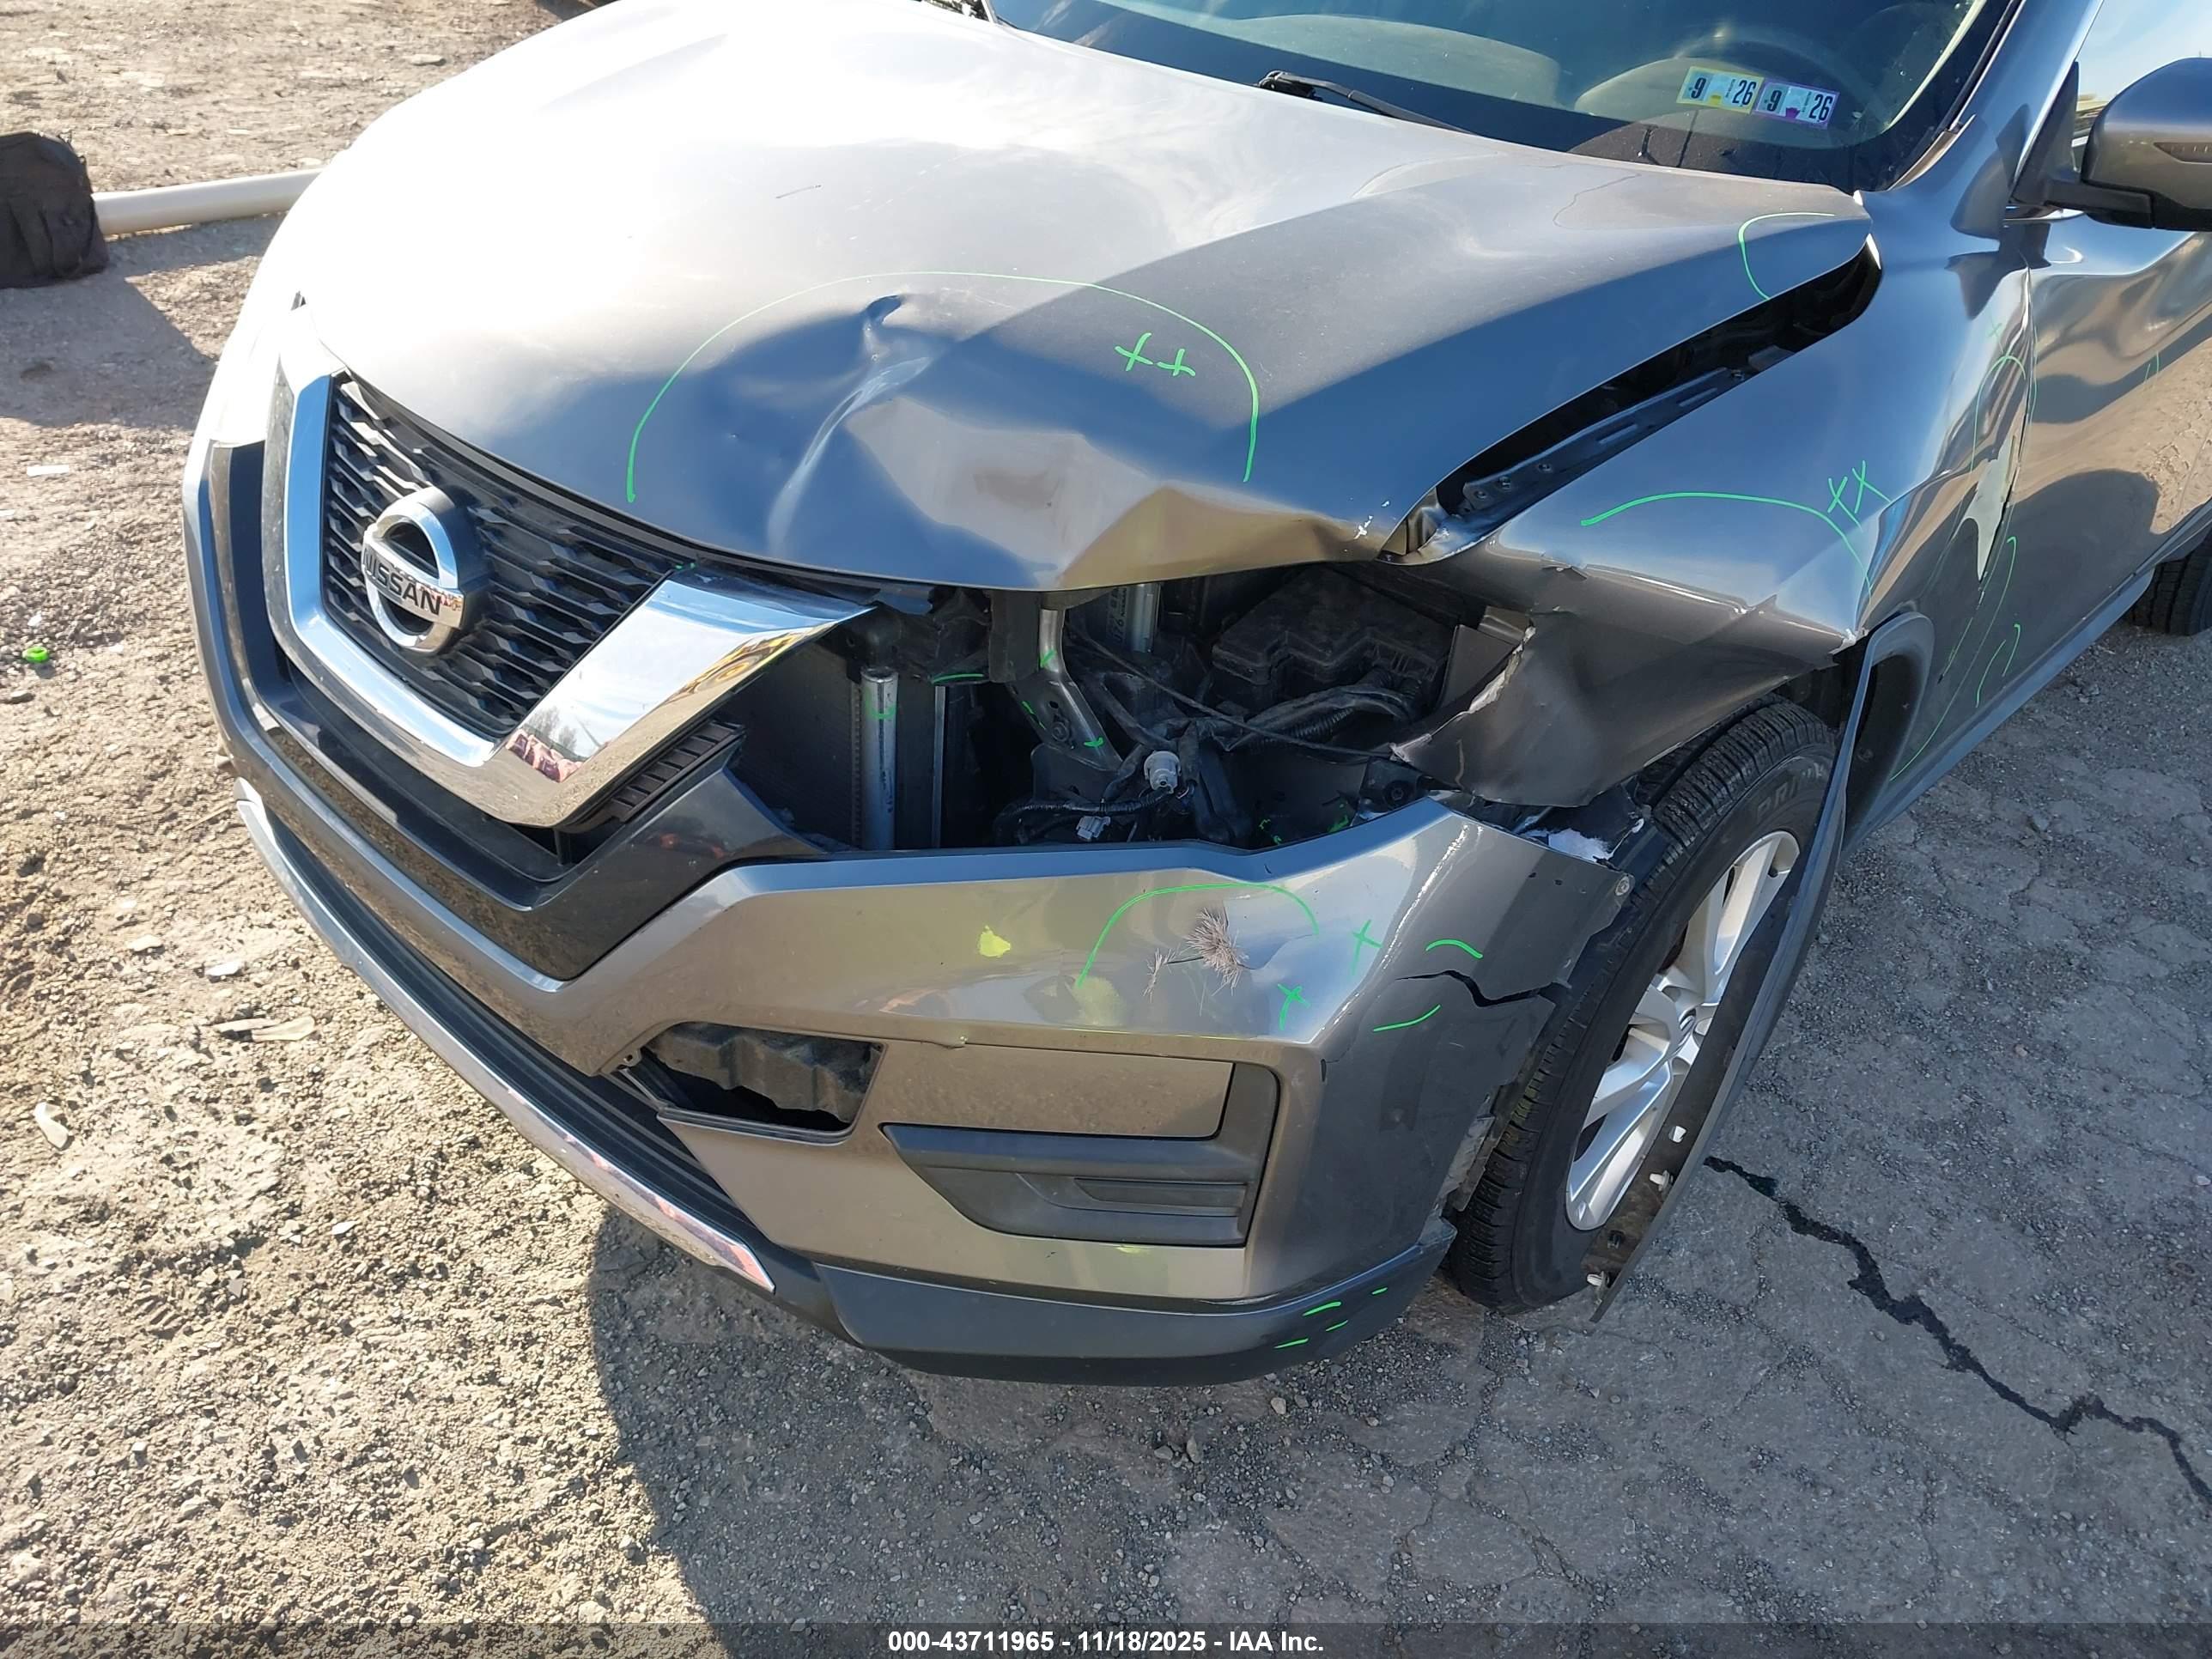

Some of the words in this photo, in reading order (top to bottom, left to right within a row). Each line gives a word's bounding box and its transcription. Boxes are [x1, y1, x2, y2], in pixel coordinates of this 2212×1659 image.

[1690, 77, 1707, 99] 9
[1731, 79, 1757, 106] 26
[1766, 89, 1783, 112] 9
[1808, 94, 1833, 121] 26
[363, 546, 441, 616] NISSAN
